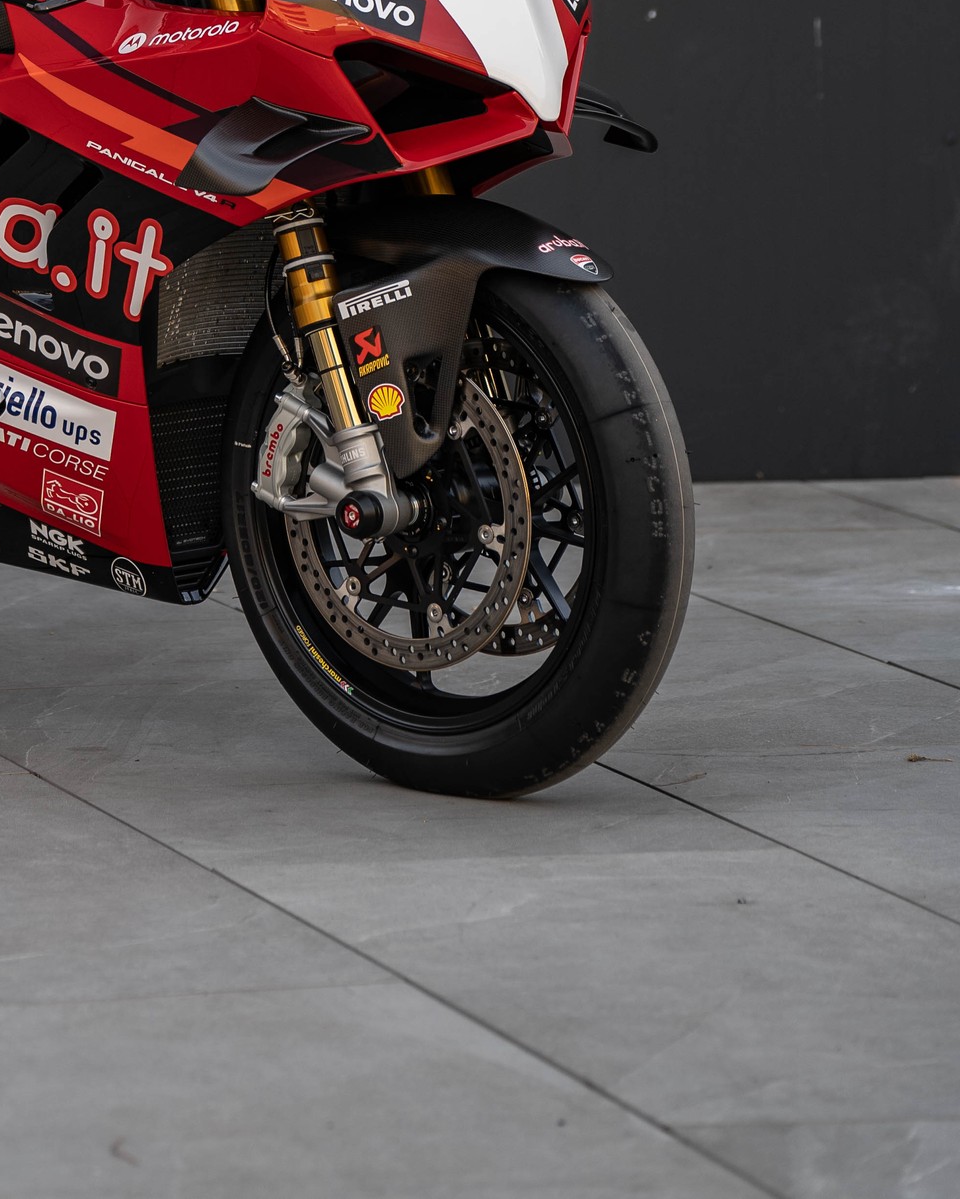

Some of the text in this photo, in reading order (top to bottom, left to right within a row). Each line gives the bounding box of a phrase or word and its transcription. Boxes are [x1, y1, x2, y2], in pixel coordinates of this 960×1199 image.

[149, 20, 240, 47] motorola
[86, 140, 188, 191] PANIGAL
[337, 279, 413, 320] PIRELLI
[62, 420, 102, 446] ups
[262, 422, 284, 478] brembo
[33, 443, 110, 481] CORSE
[29, 518, 85, 555] NGK
[27, 546, 91, 577] SKF
[113, 567, 144, 591] STM
